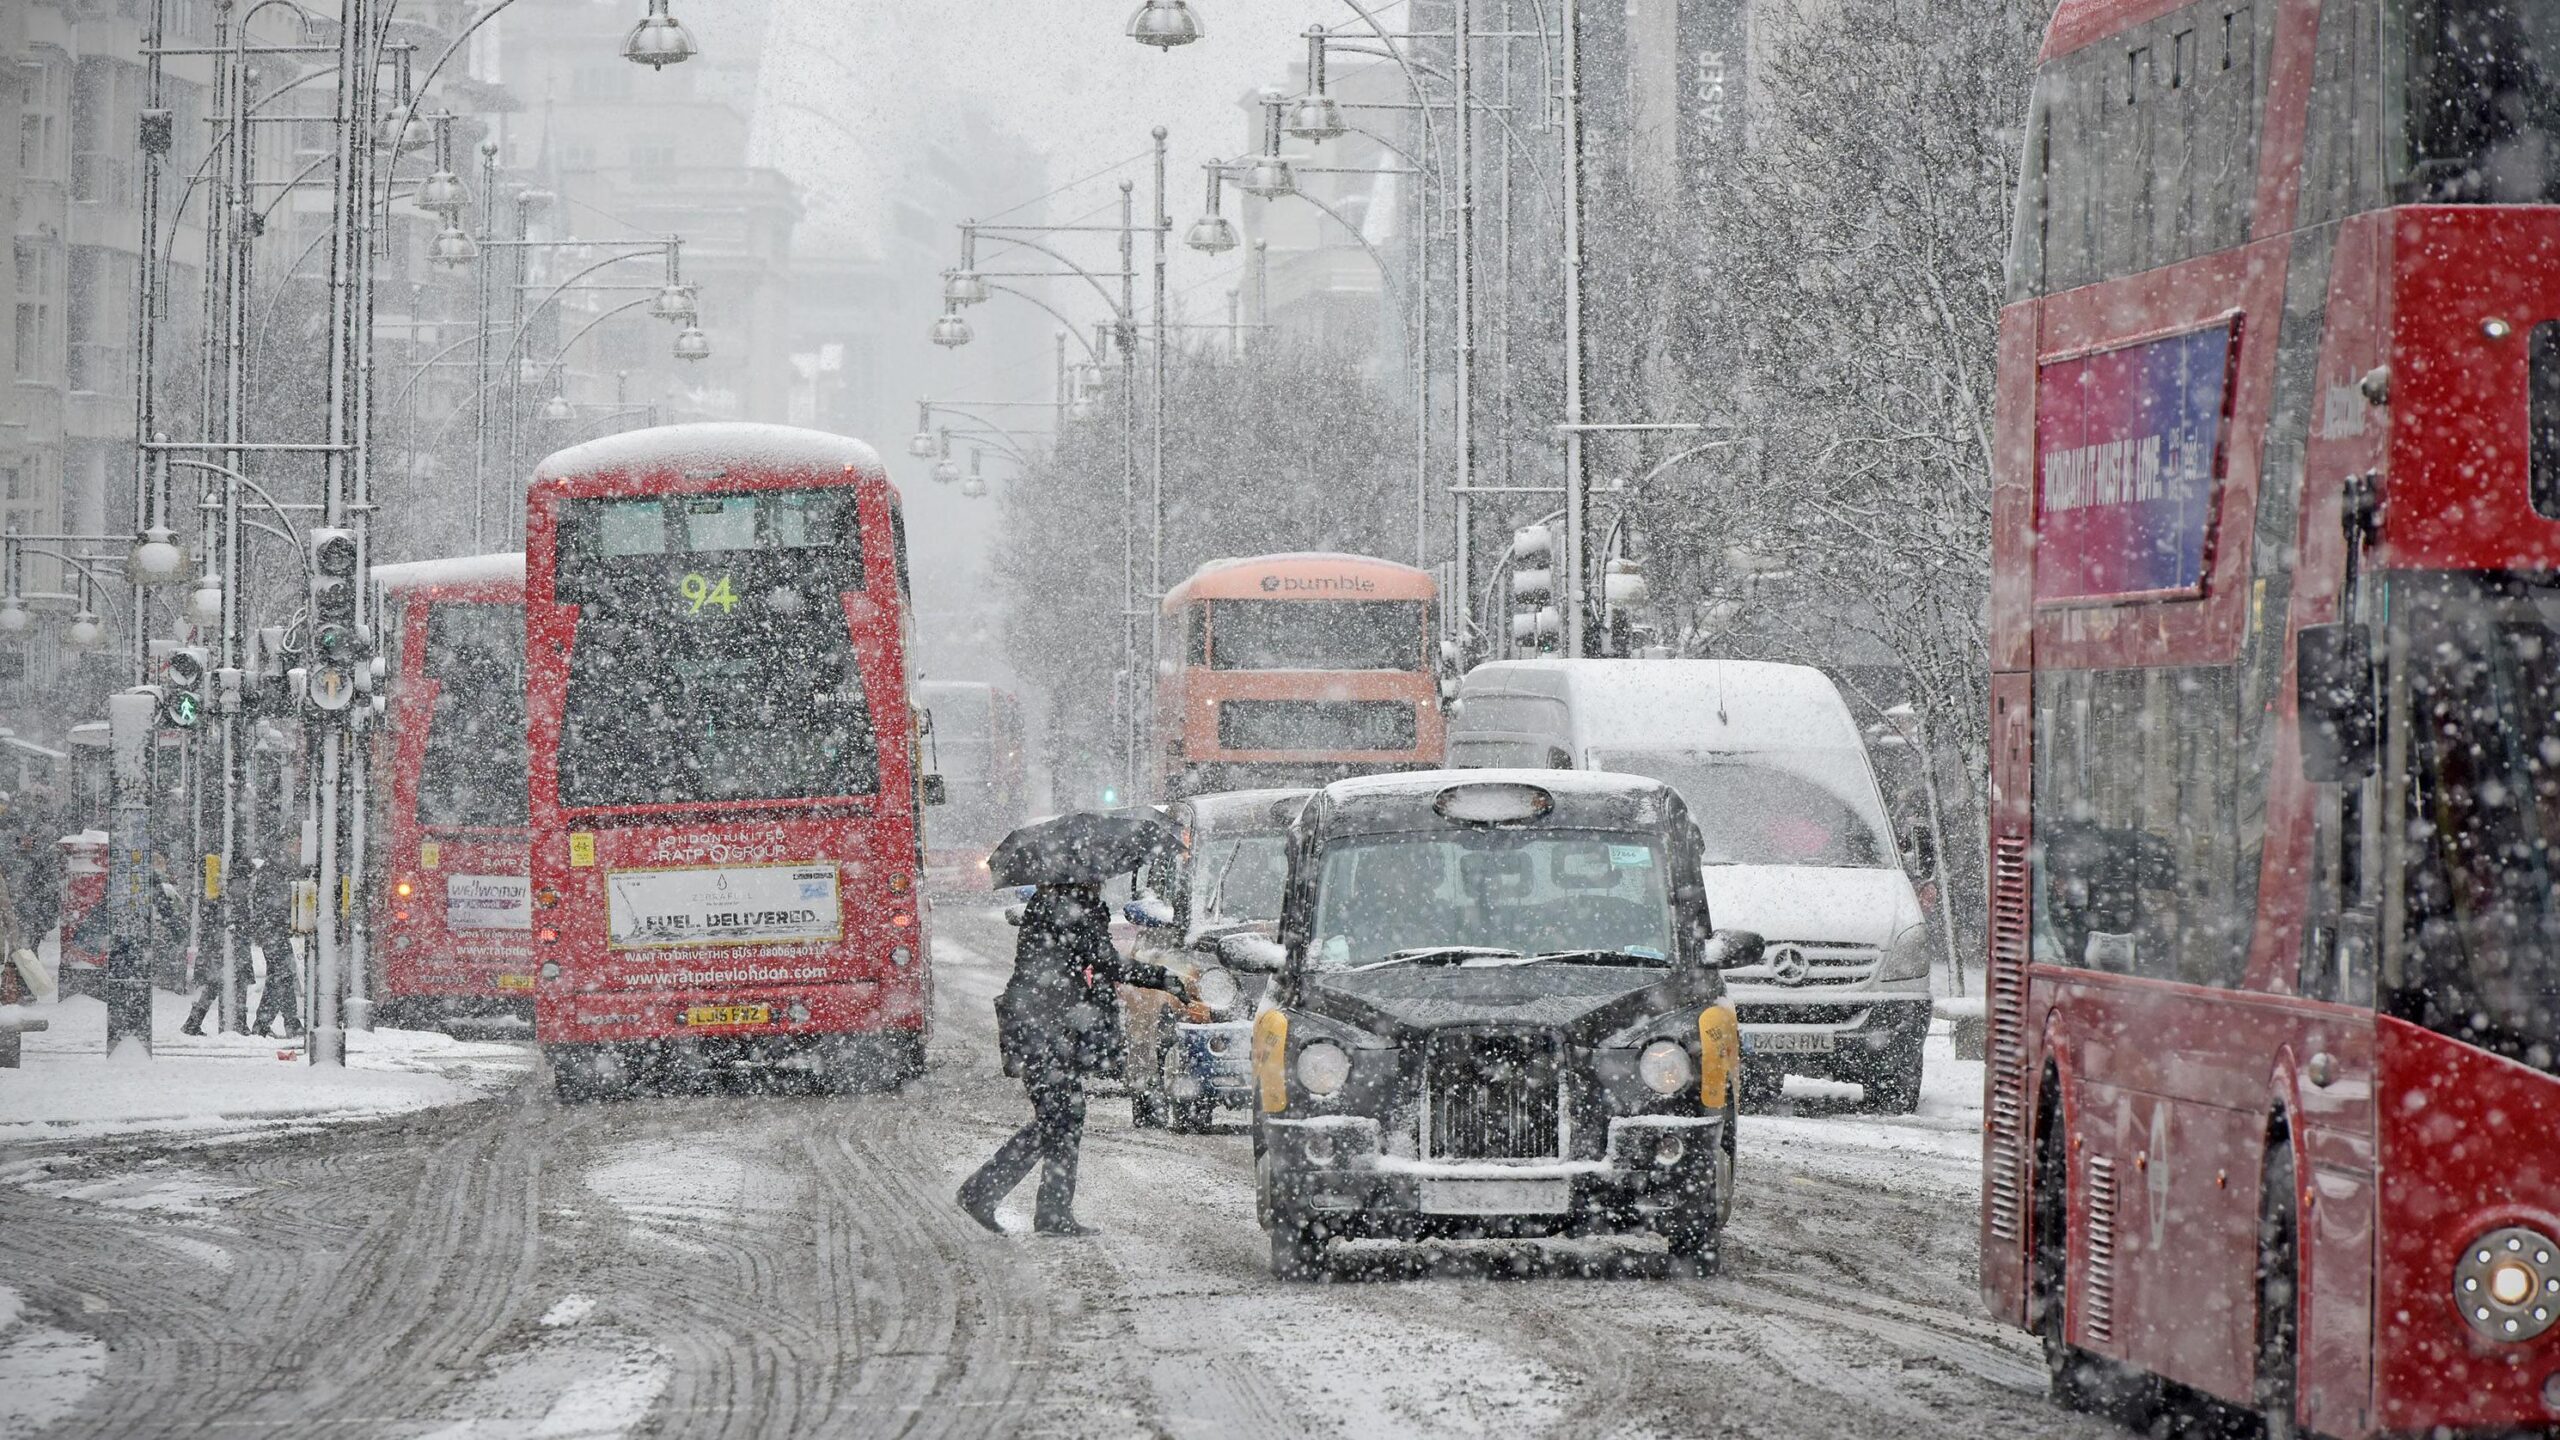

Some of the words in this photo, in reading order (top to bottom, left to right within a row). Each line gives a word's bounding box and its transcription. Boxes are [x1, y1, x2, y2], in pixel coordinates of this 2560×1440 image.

[1284, 576, 1375, 592] bumble
[681, 573, 738, 614] 94
[658, 832, 722, 848] LONDON
[659, 848, 705, 861] RATP
[732, 844, 786, 859] GROUP
[451, 880, 526, 899] wellwoman
[646, 914, 701, 930] FUEL.
[706, 909, 821, 928] DELIVERED.
[625, 952, 656, 963] WANT
[658, 952, 672, 961] TO
[674, 950, 704, 961] DRIVE
[707, 949, 730, 960] THIS
[625, 965, 828, 987] www.ratpdevlondon.com
